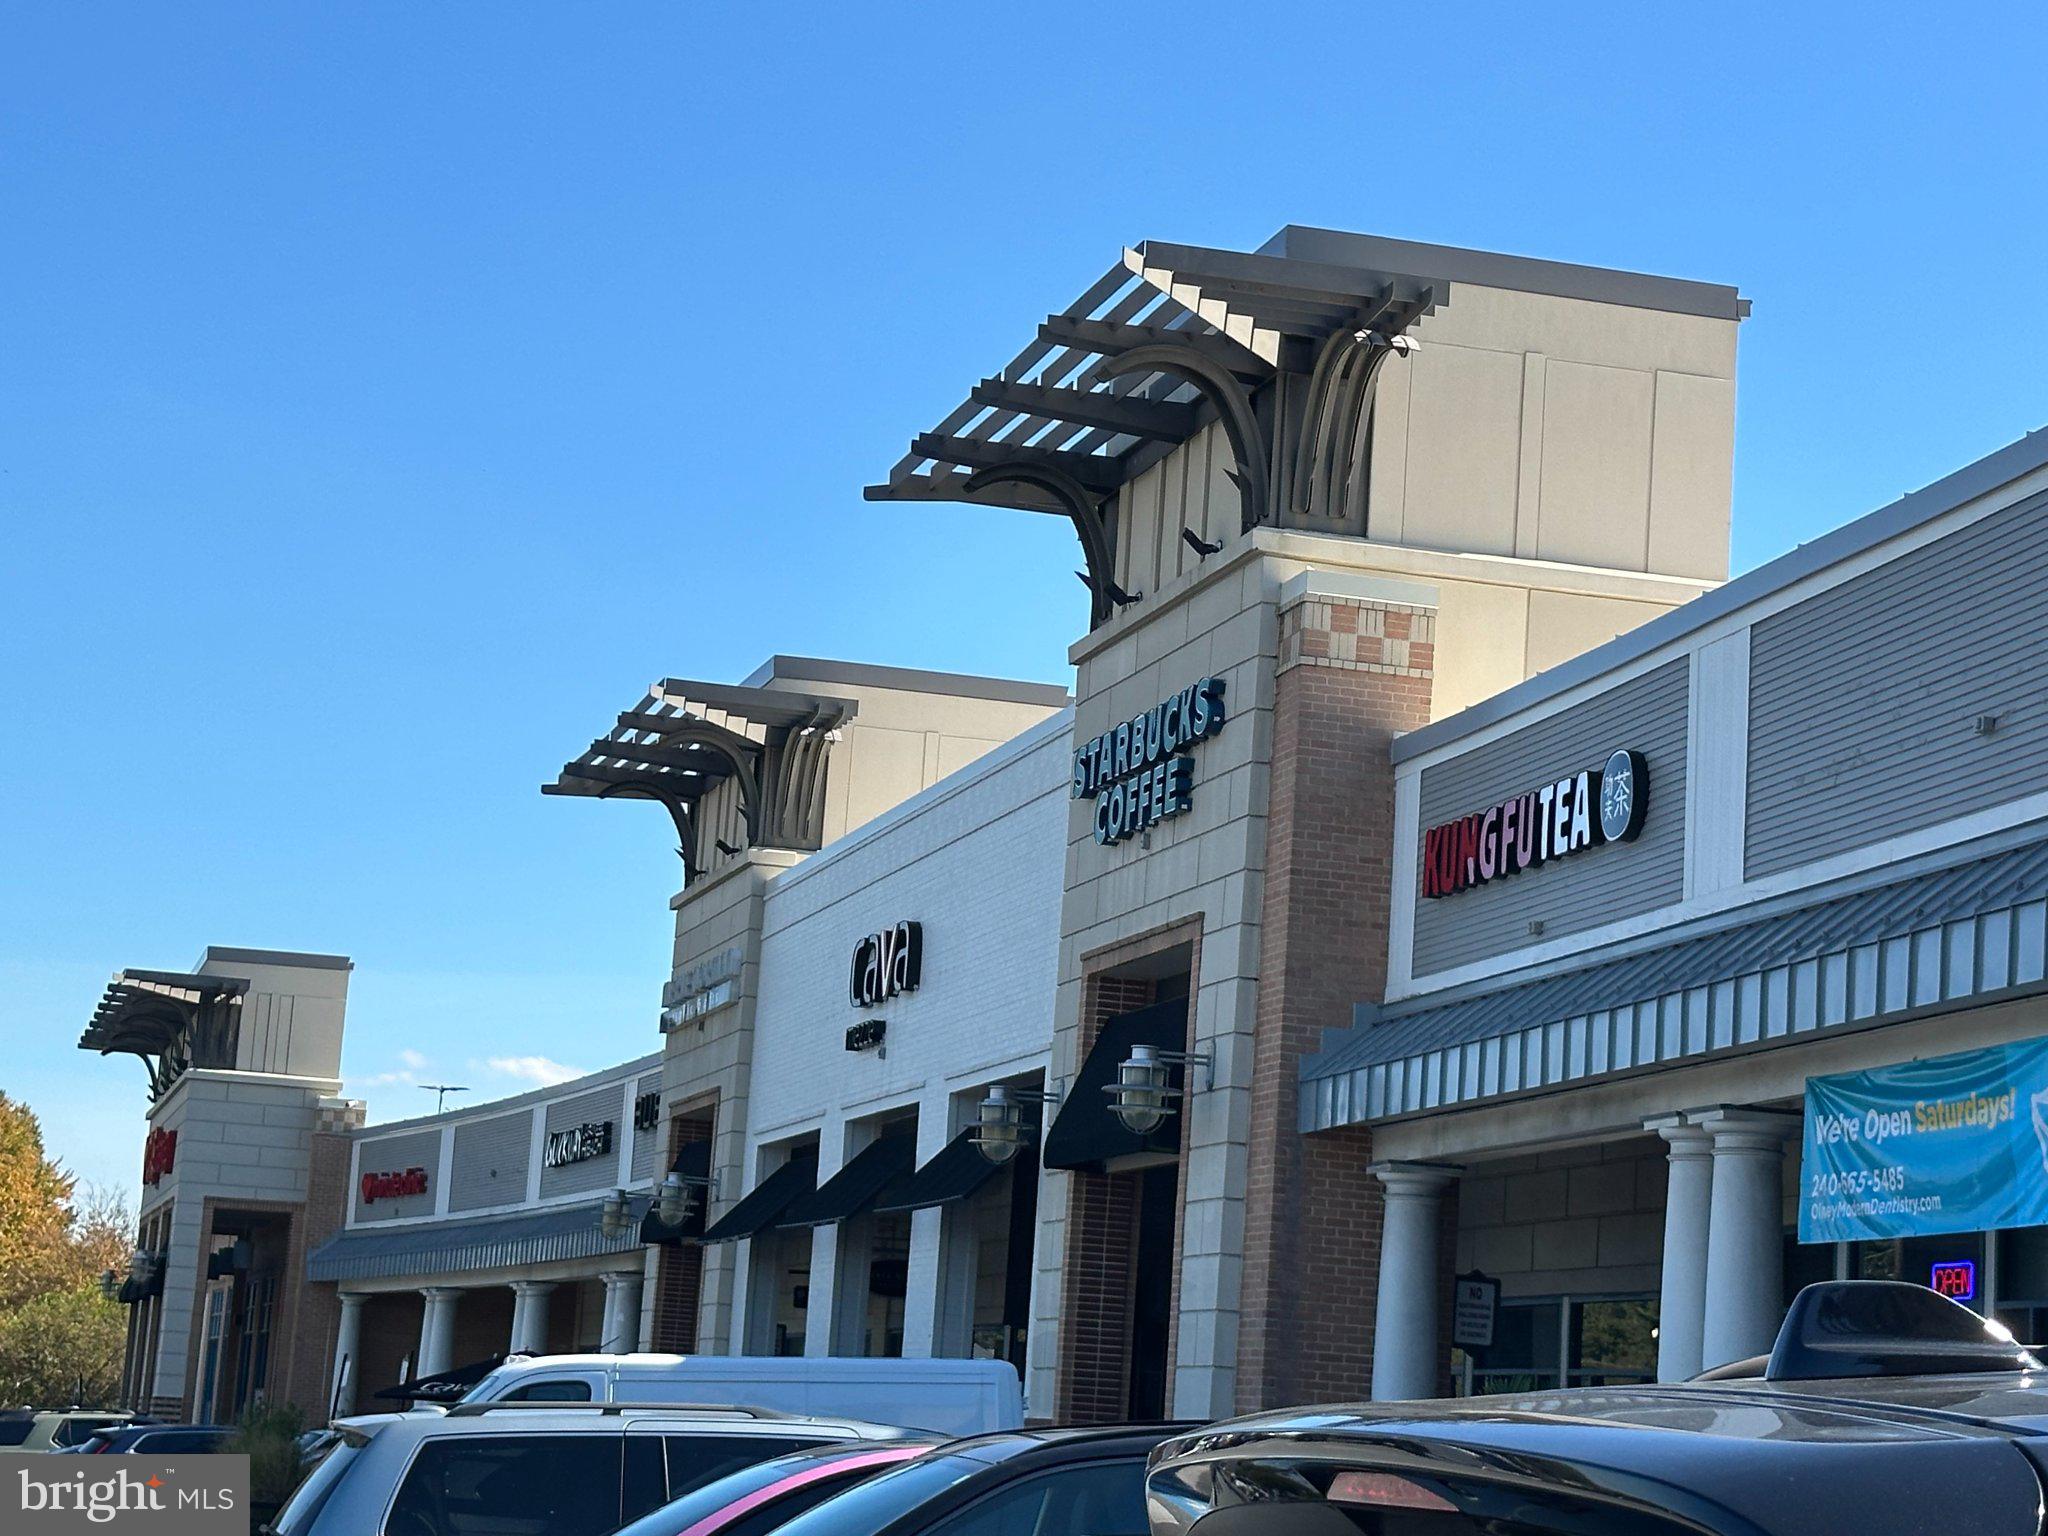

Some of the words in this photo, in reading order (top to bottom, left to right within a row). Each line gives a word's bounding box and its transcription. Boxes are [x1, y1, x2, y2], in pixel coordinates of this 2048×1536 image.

[1072, 677, 1225, 799] STARBUCKS
[1094, 757, 1192, 846] COFFEE
[1815, 1112, 1859, 1145] We're
[1865, 1108, 1911, 1144] Open
[1915, 1087, 2017, 1133] Saturdays!
[1469, 1286, 1483, 1300] NO
[1934, 1268, 1970, 1295] OPEN
